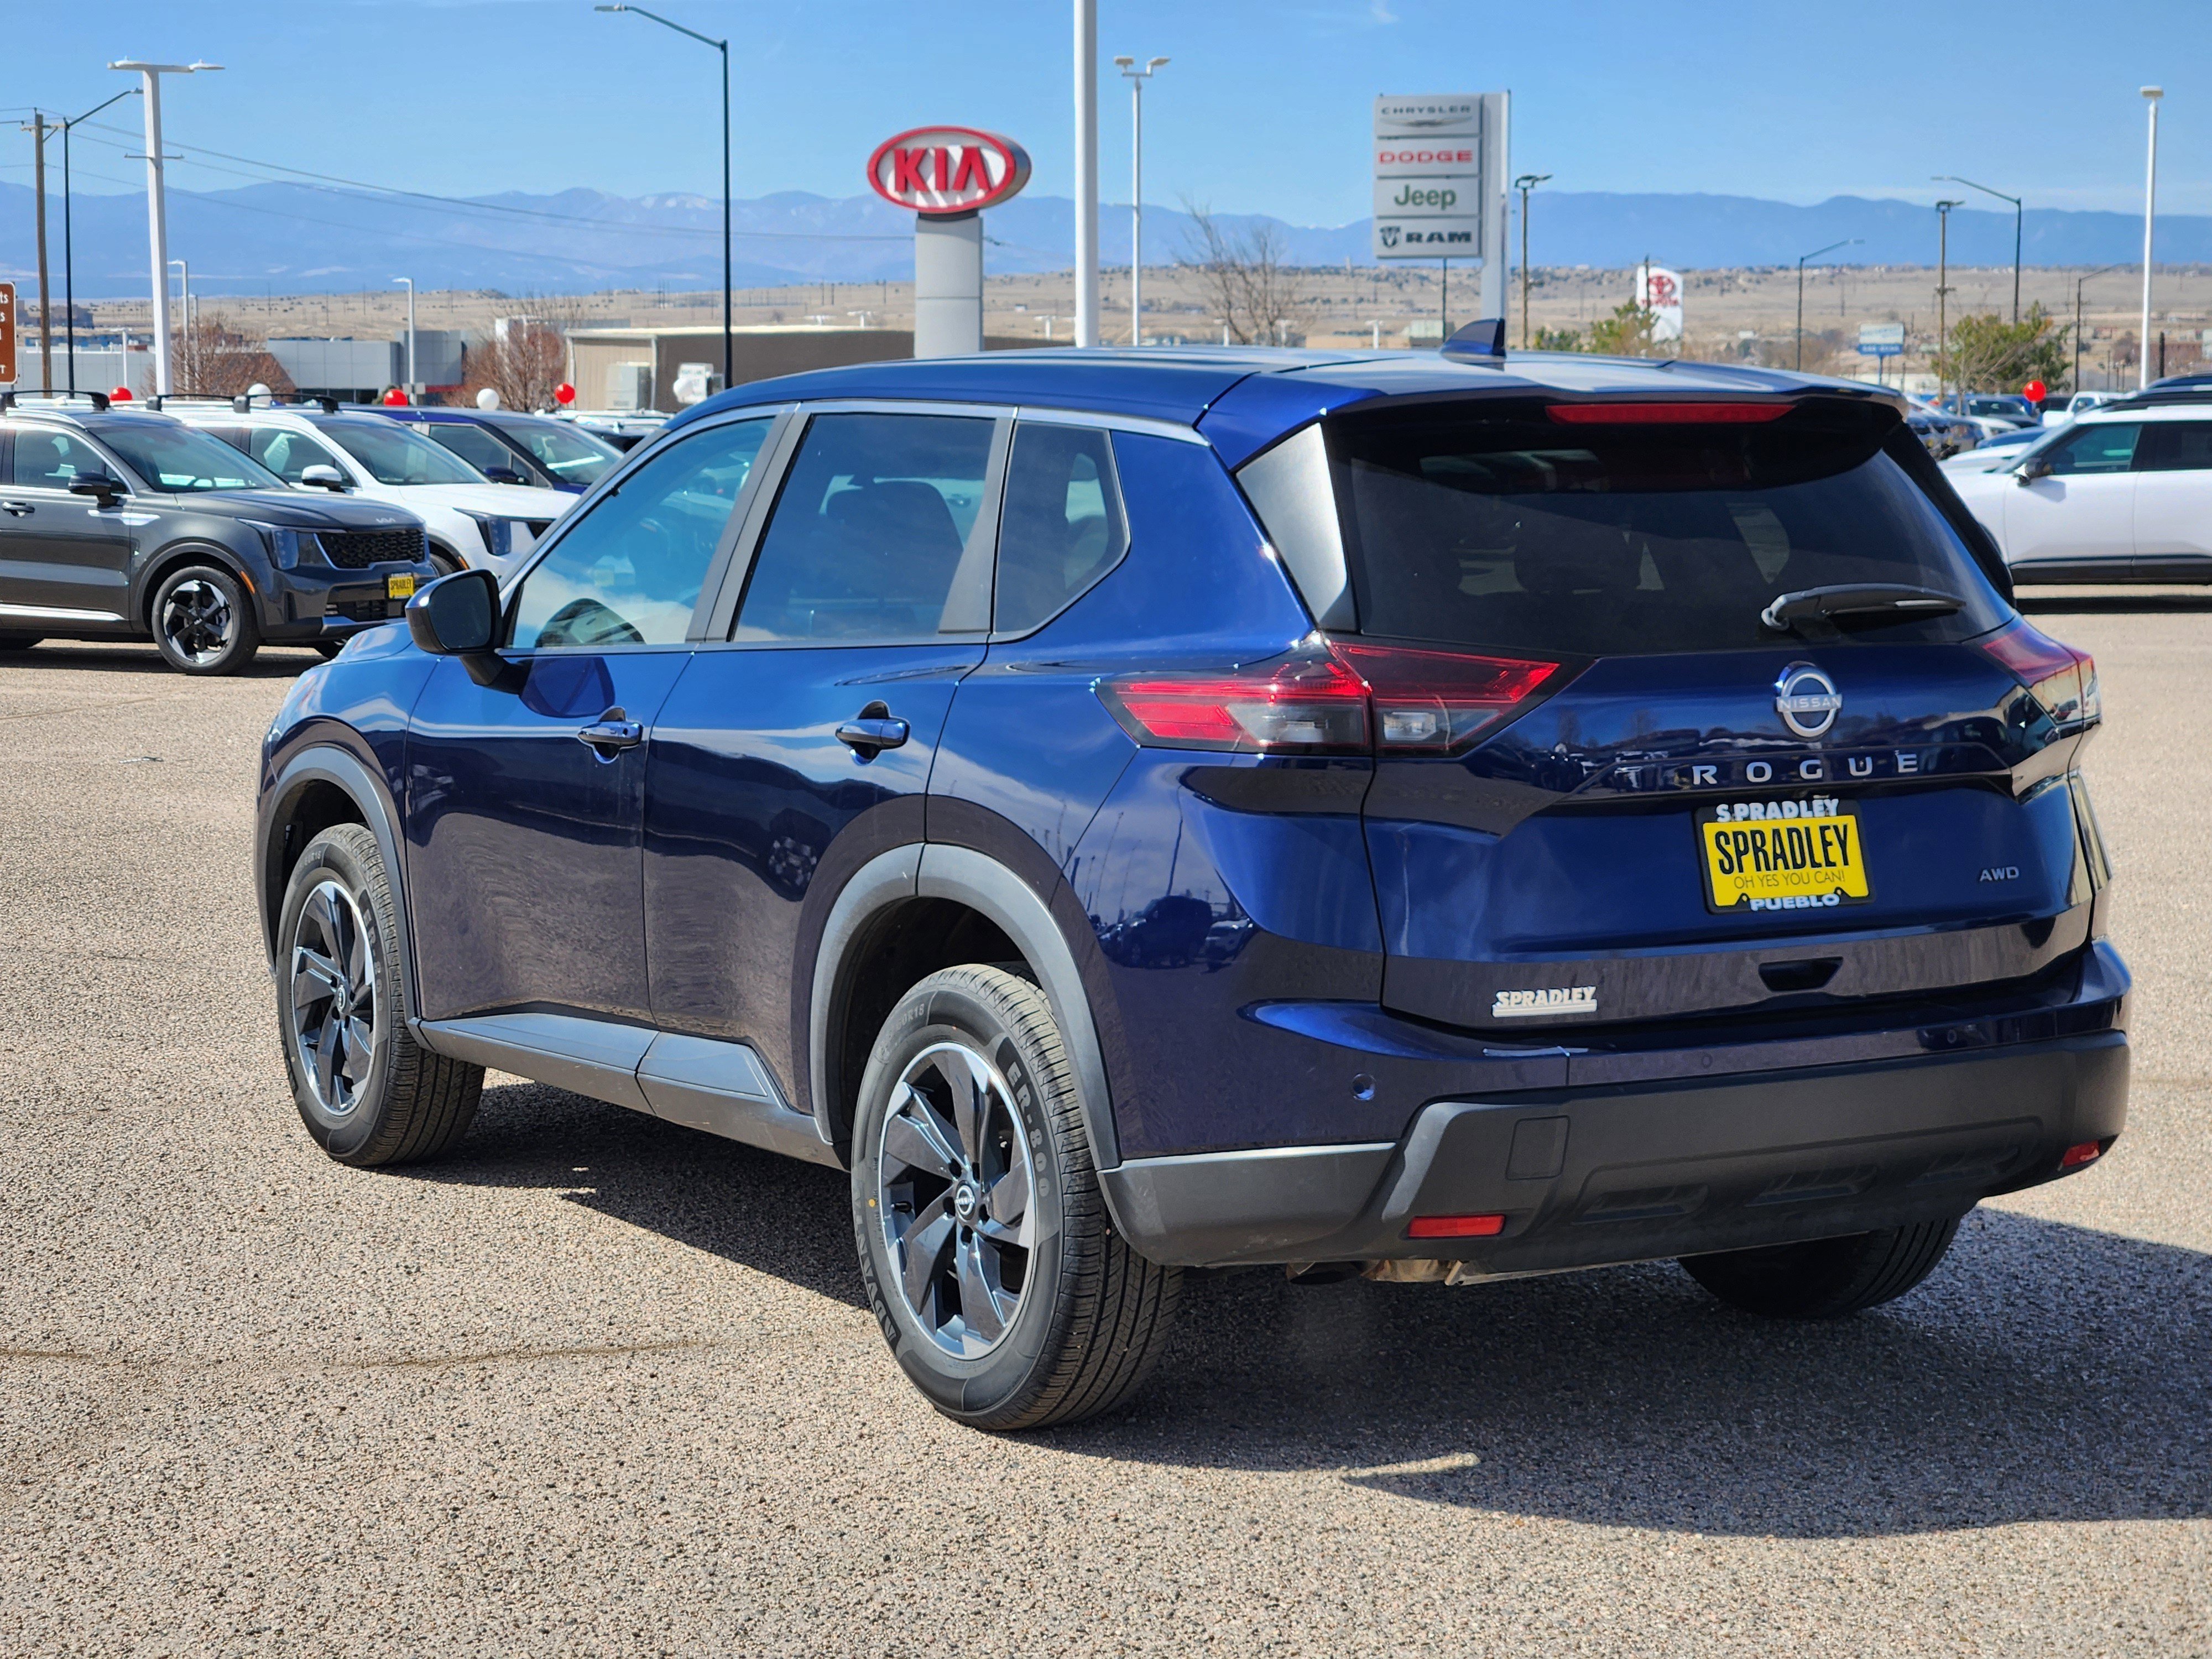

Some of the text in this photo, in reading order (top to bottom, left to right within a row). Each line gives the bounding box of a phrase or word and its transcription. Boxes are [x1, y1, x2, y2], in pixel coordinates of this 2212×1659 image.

[1381, 105, 1471, 114] CHRYSLER
[1379, 150, 1473, 164] DODGE
[894, 146, 993, 192] KIA
[1394, 184, 1457, 211] Jeep
[1406, 231, 1472, 243] RAM
[1778, 697, 1840, 710] NISSAN
[1692, 753, 1918, 785] ROGUE
[1716, 798, 1839, 823] SPRADLEY
[1714, 823, 1850, 875] SPRADLEY
[1734, 869, 1845, 889] OH YES YOU CAN!
[1979, 866, 2020, 881] AWD
[1750, 893, 1840, 912] PUEBLO
[1495, 986, 1597, 1008] SPRADLEY
[1006, 1061, 1050, 1198] ER-800
